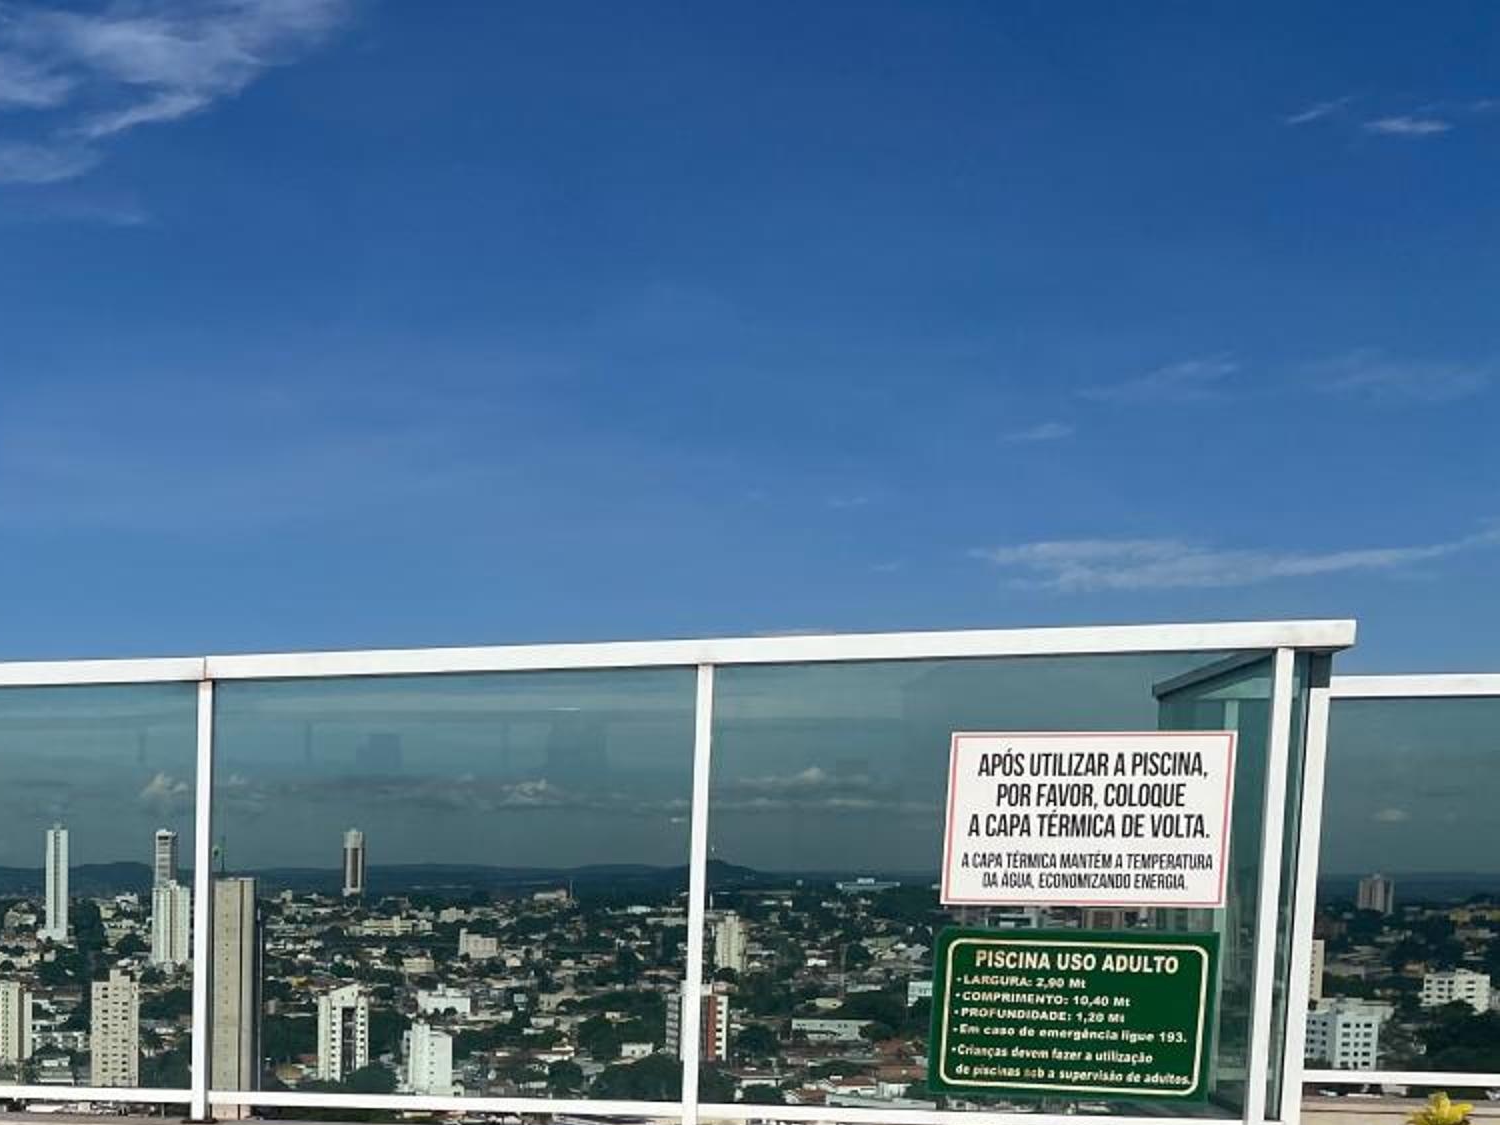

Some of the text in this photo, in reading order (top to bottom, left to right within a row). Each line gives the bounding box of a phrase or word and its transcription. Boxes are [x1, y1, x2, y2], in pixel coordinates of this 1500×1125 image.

[977, 748, 1208, 779] APÓS UTILIZAR A PISCINA,
[996, 783, 1186, 810] POR FAVOR, COLOQUE
[968, 809, 1210, 838] A CAPA TÉRMICA DE VOLTA.
[961, 850, 1213, 870] A CAPA TÉRMICA MANTÉM A TEMPERATURA
[982, 872, 998, 888] DA
[1001, 870, 1034, 889] ÁGUA,
[1038, 873, 1131, 889] ECONOMIZANDO
[975, 950, 1179, 974] PISCINA USO ADULTO
[963, 974, 1033, 987] LARGURA:
[962, 991, 1069, 1005] COMPRIMENTO:
[961, 1007, 1072, 1021] PROFUNDIDADE:
[959, 1023, 1187, 1043] Em caso de emergência ligue 193.
[957, 1044, 1007, 1060] Crianças
[1052, 1048, 1082, 1061] fazer
[1084, 1050, 1092, 1061] a
[1095, 1051, 1153, 1066] utilização
[955, 1064, 970, 1074] de
[973, 1065, 1021, 1077] piscinas
[1047, 1069, 1055, 1079] a
[1125, 1072, 1141, 1083] de
